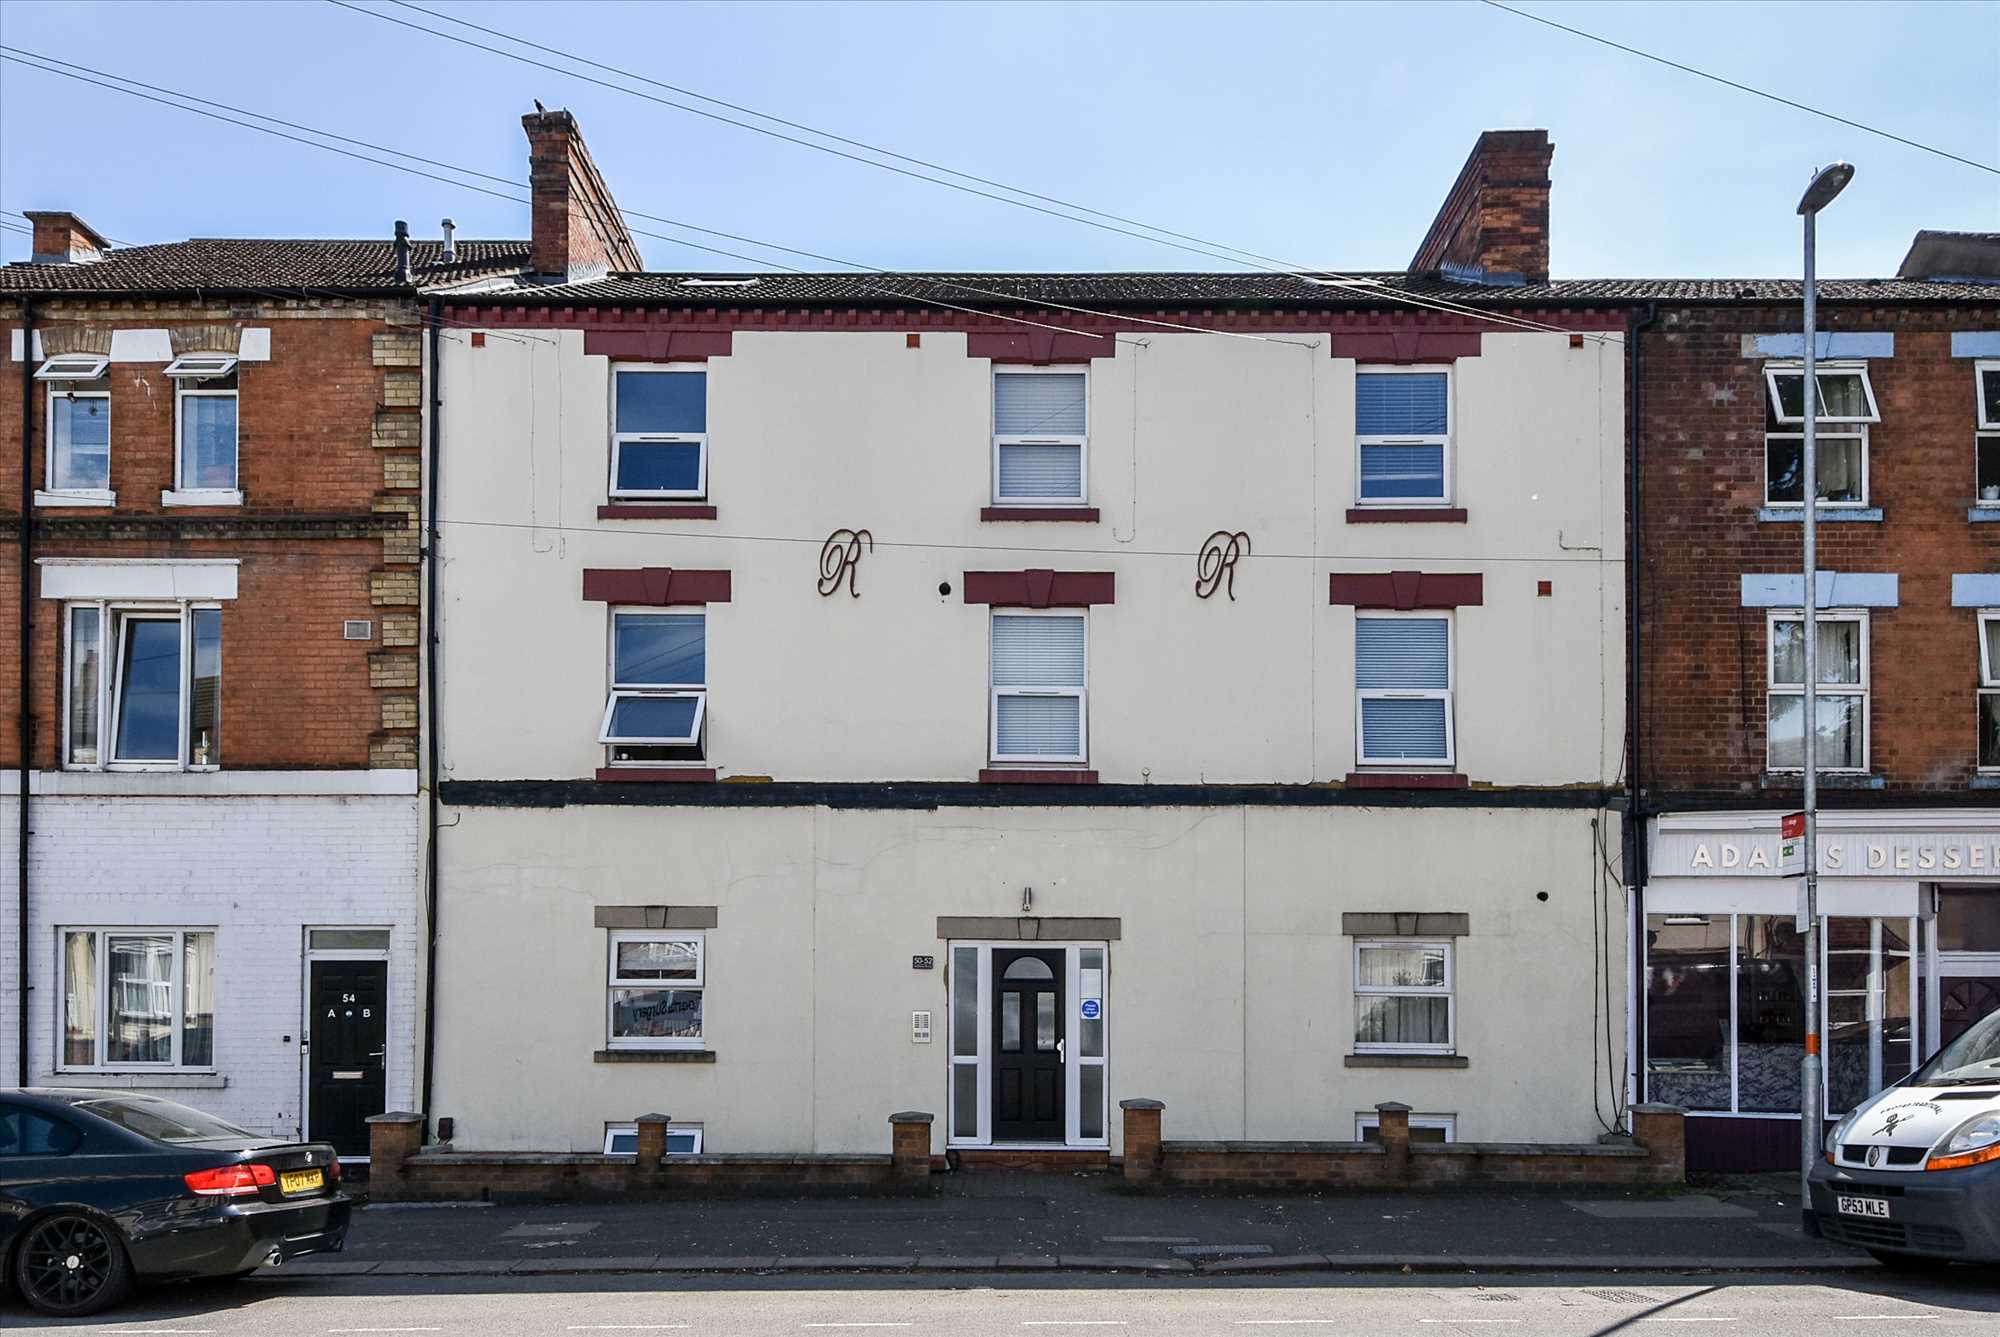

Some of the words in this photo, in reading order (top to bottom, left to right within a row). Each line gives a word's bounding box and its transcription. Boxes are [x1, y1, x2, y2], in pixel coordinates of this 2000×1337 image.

[1690, 844, 1843, 869] ADAS
[342, 993, 356, 1003] 54
[327, 1008, 337, 1018] A
[362, 1008, 371, 1018] B
[1841, 1197, 1864, 1214] GP53
